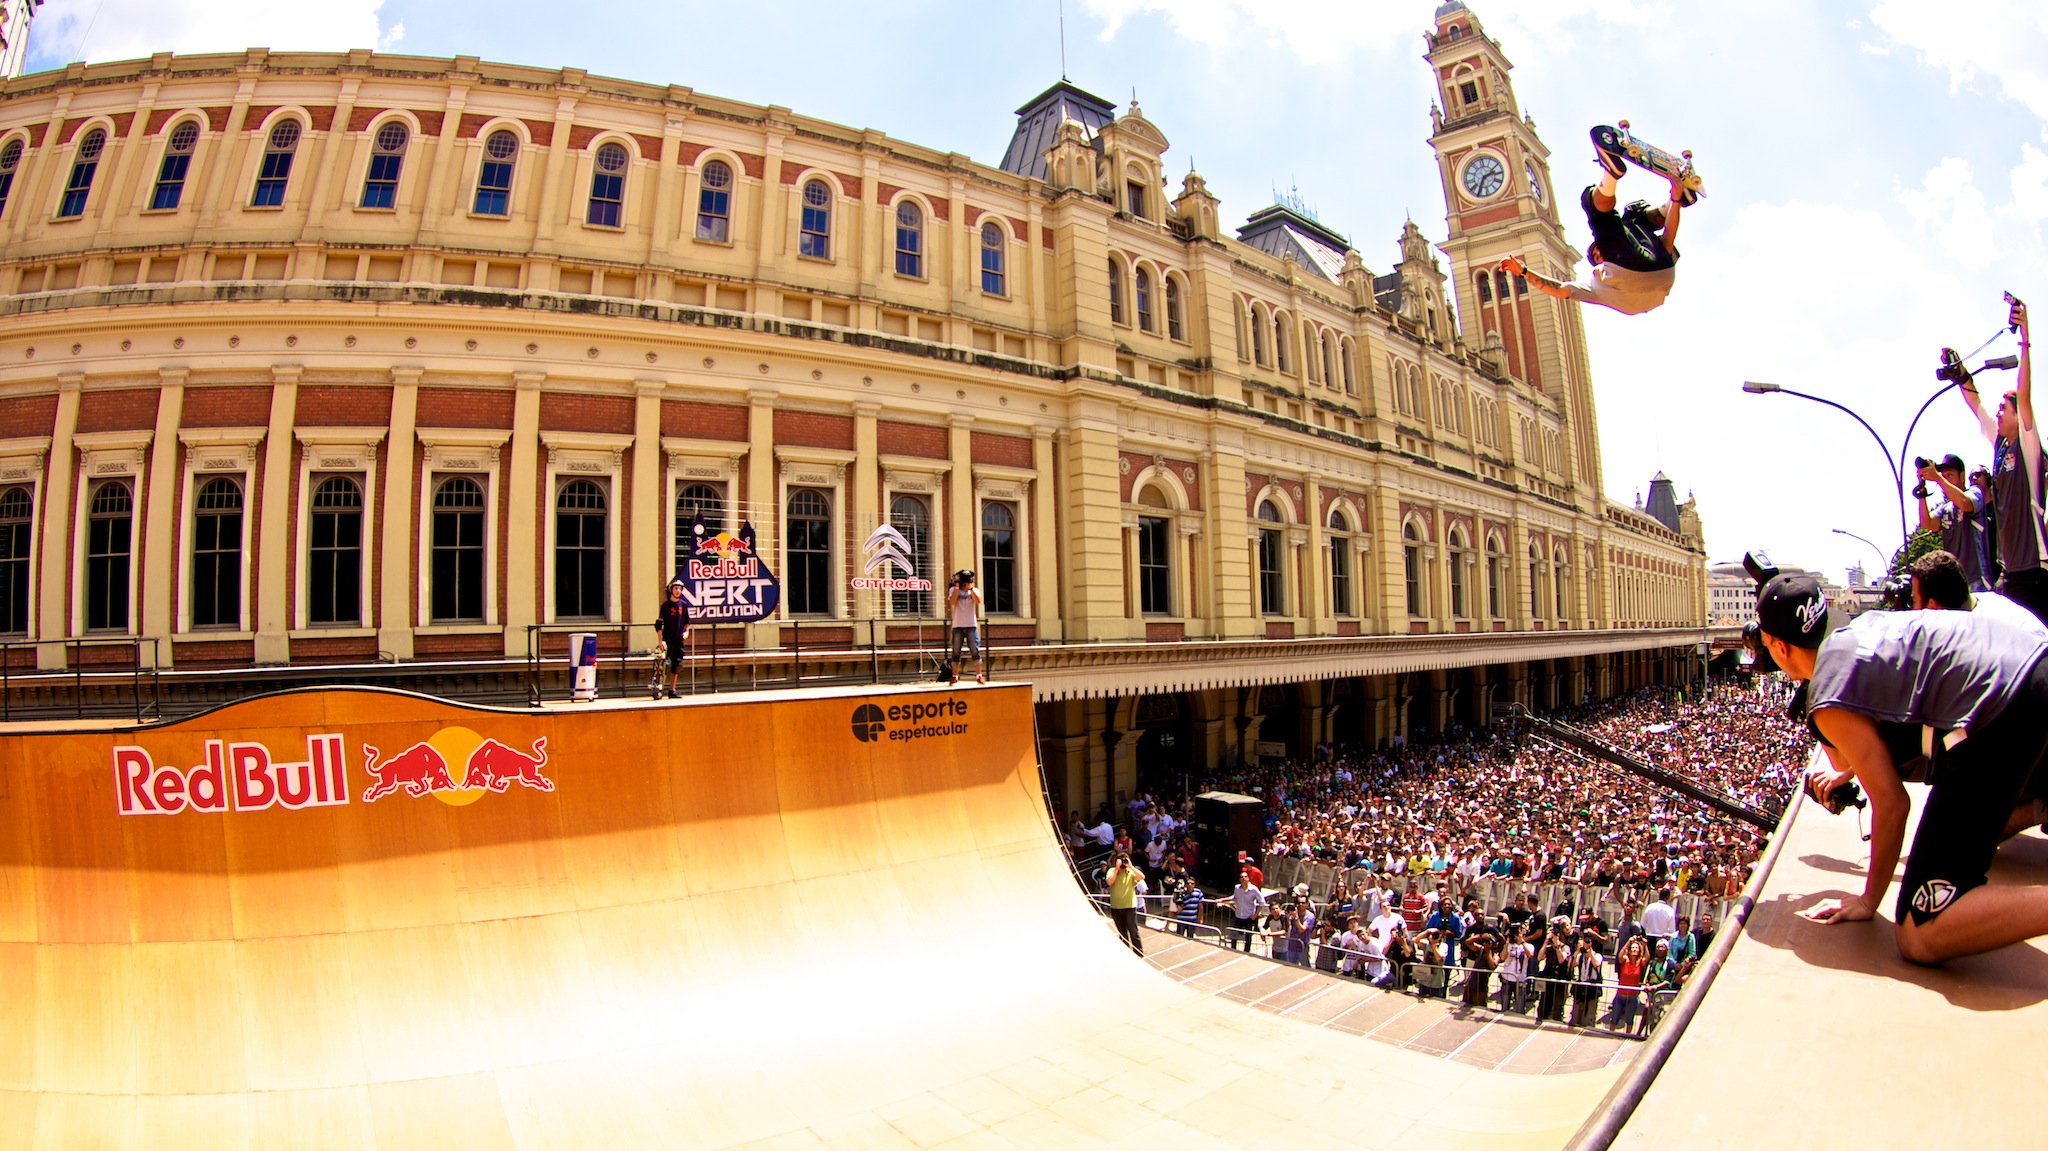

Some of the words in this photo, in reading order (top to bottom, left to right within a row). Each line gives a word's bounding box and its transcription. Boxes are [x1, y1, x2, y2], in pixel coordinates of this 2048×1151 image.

[689, 559, 724, 579] Red
[725, 558, 757, 578] Bull
[682, 579, 773, 606] VERT
[687, 604, 763, 619] EVOLUTION
[888, 697, 967, 725] esporte
[889, 721, 968, 742] espetacular
[116, 742, 226, 813] Red
[231, 735, 347, 810] Bull
